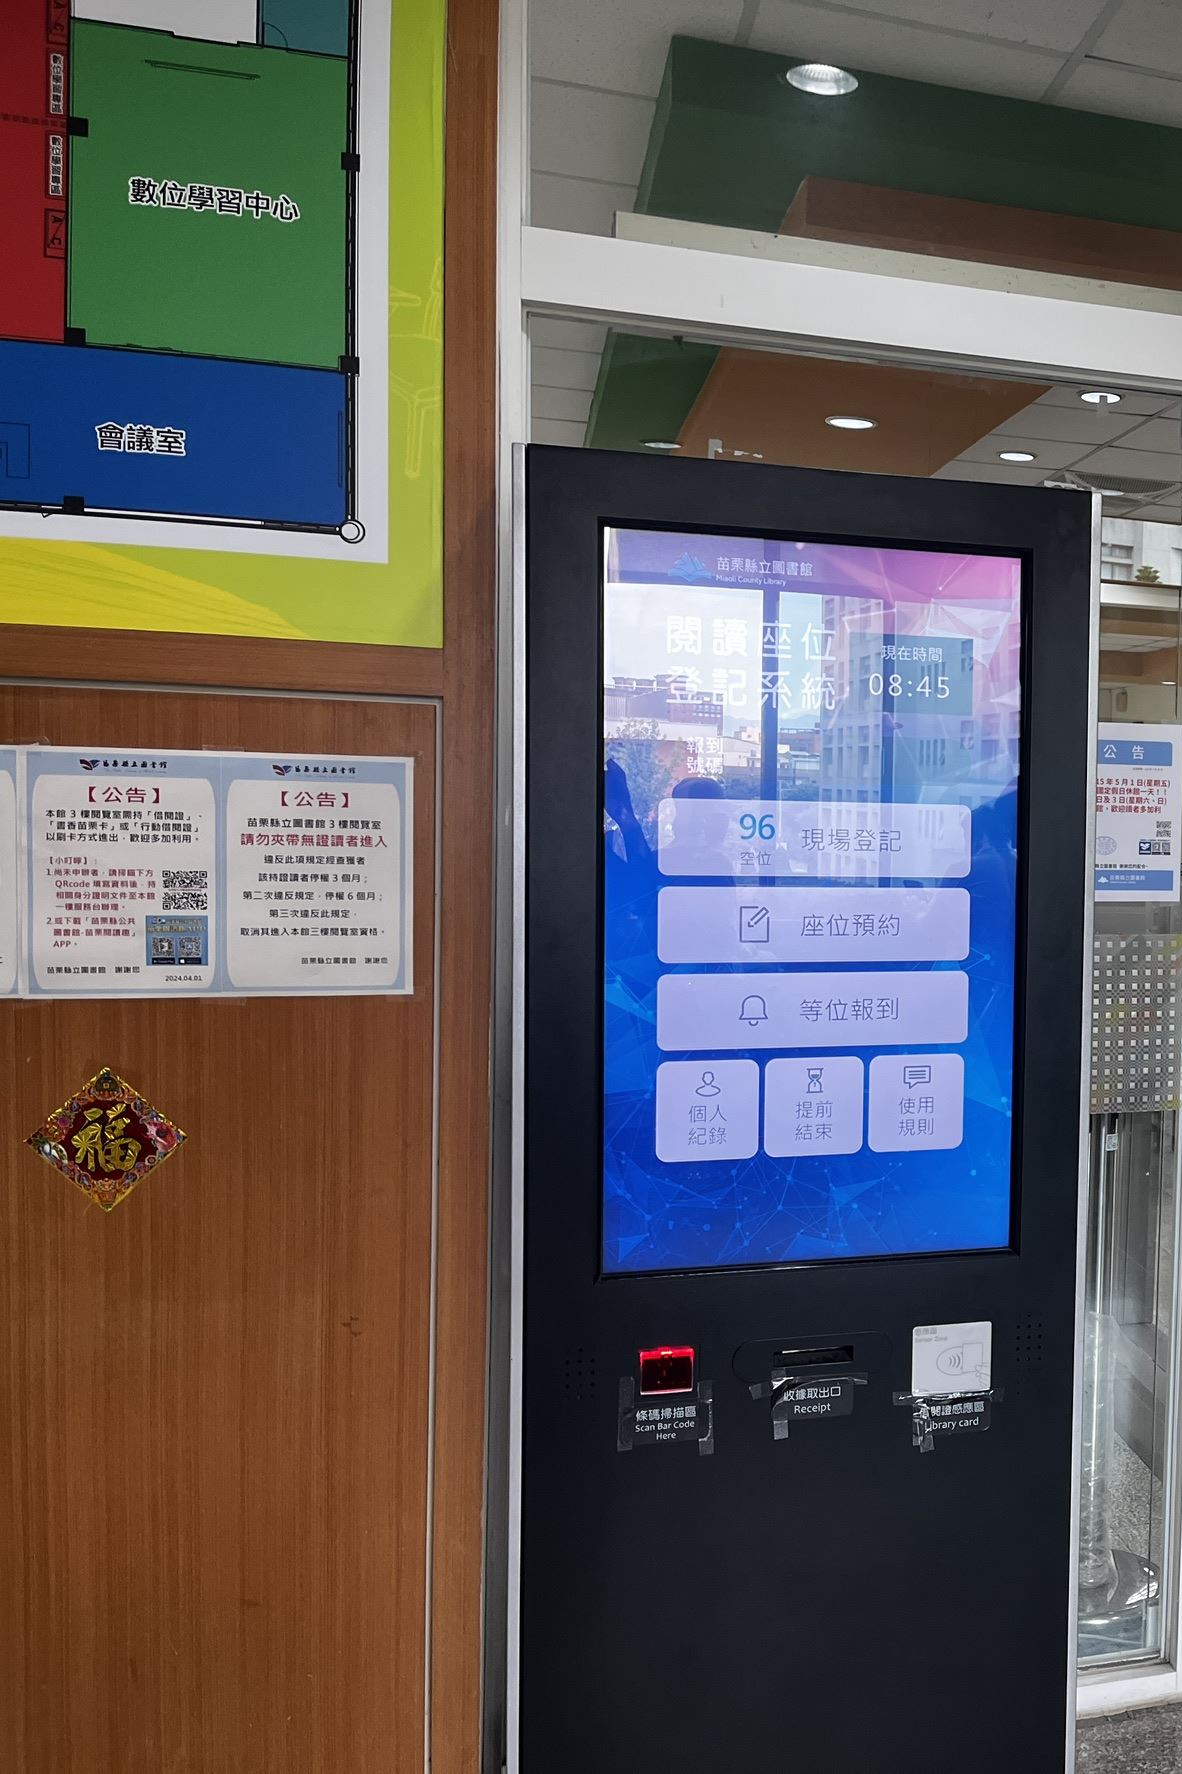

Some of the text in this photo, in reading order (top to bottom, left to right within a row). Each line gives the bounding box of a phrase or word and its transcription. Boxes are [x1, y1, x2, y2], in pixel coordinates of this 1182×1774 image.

[129, 177, 300, 222] 數位學習中心
[96, 422, 186, 456] 會議室
[716, 556, 813, 577] 苗栗縣立圖書館
[716, 574, 786, 587] Miaoli County Library
[665, 615, 837, 662] 閱讀座位
[881, 645, 943, 664] 現在時間
[665, 665, 836, 711] 登記系統
[869, 672, 951, 700] 08:45
[686, 736, 723, 754] 報到
[1103, 744, 1145, 760] 公告
[739, 813, 776, 841] 96
[240, 833, 388, 849] 請勿夾帶無證讀者進入
[801, 828, 903, 854] 現場登記
[263, 854, 366, 865] 違反此項規定經查獲者
[739, 850, 772, 867] 空位
[55, 880, 91, 889] QRcode
[800, 913, 901, 938] 座位預約
[800, 996, 900, 1022] 等位報到
[688, 1103, 727, 1124] 個人
[795, 1100, 833, 1120] 提前
[898, 1096, 935, 1115] 使用
[687, 1126, 727, 1146] 紀錄
[795, 1123, 833, 1141] 結束
[898, 1118, 935, 1137] 規則
[71, 1103, 142, 1172] 福
[783, 1386, 841, 1401] 收據取出口
[635, 1405, 697, 1422] 條碼掃描區
[794, 1402, 831, 1414] Receipt
[635, 1420, 695, 1433] Scan Bar Code
[958, 1416, 979, 1427] card
[656, 1432, 677, 1440] Here
